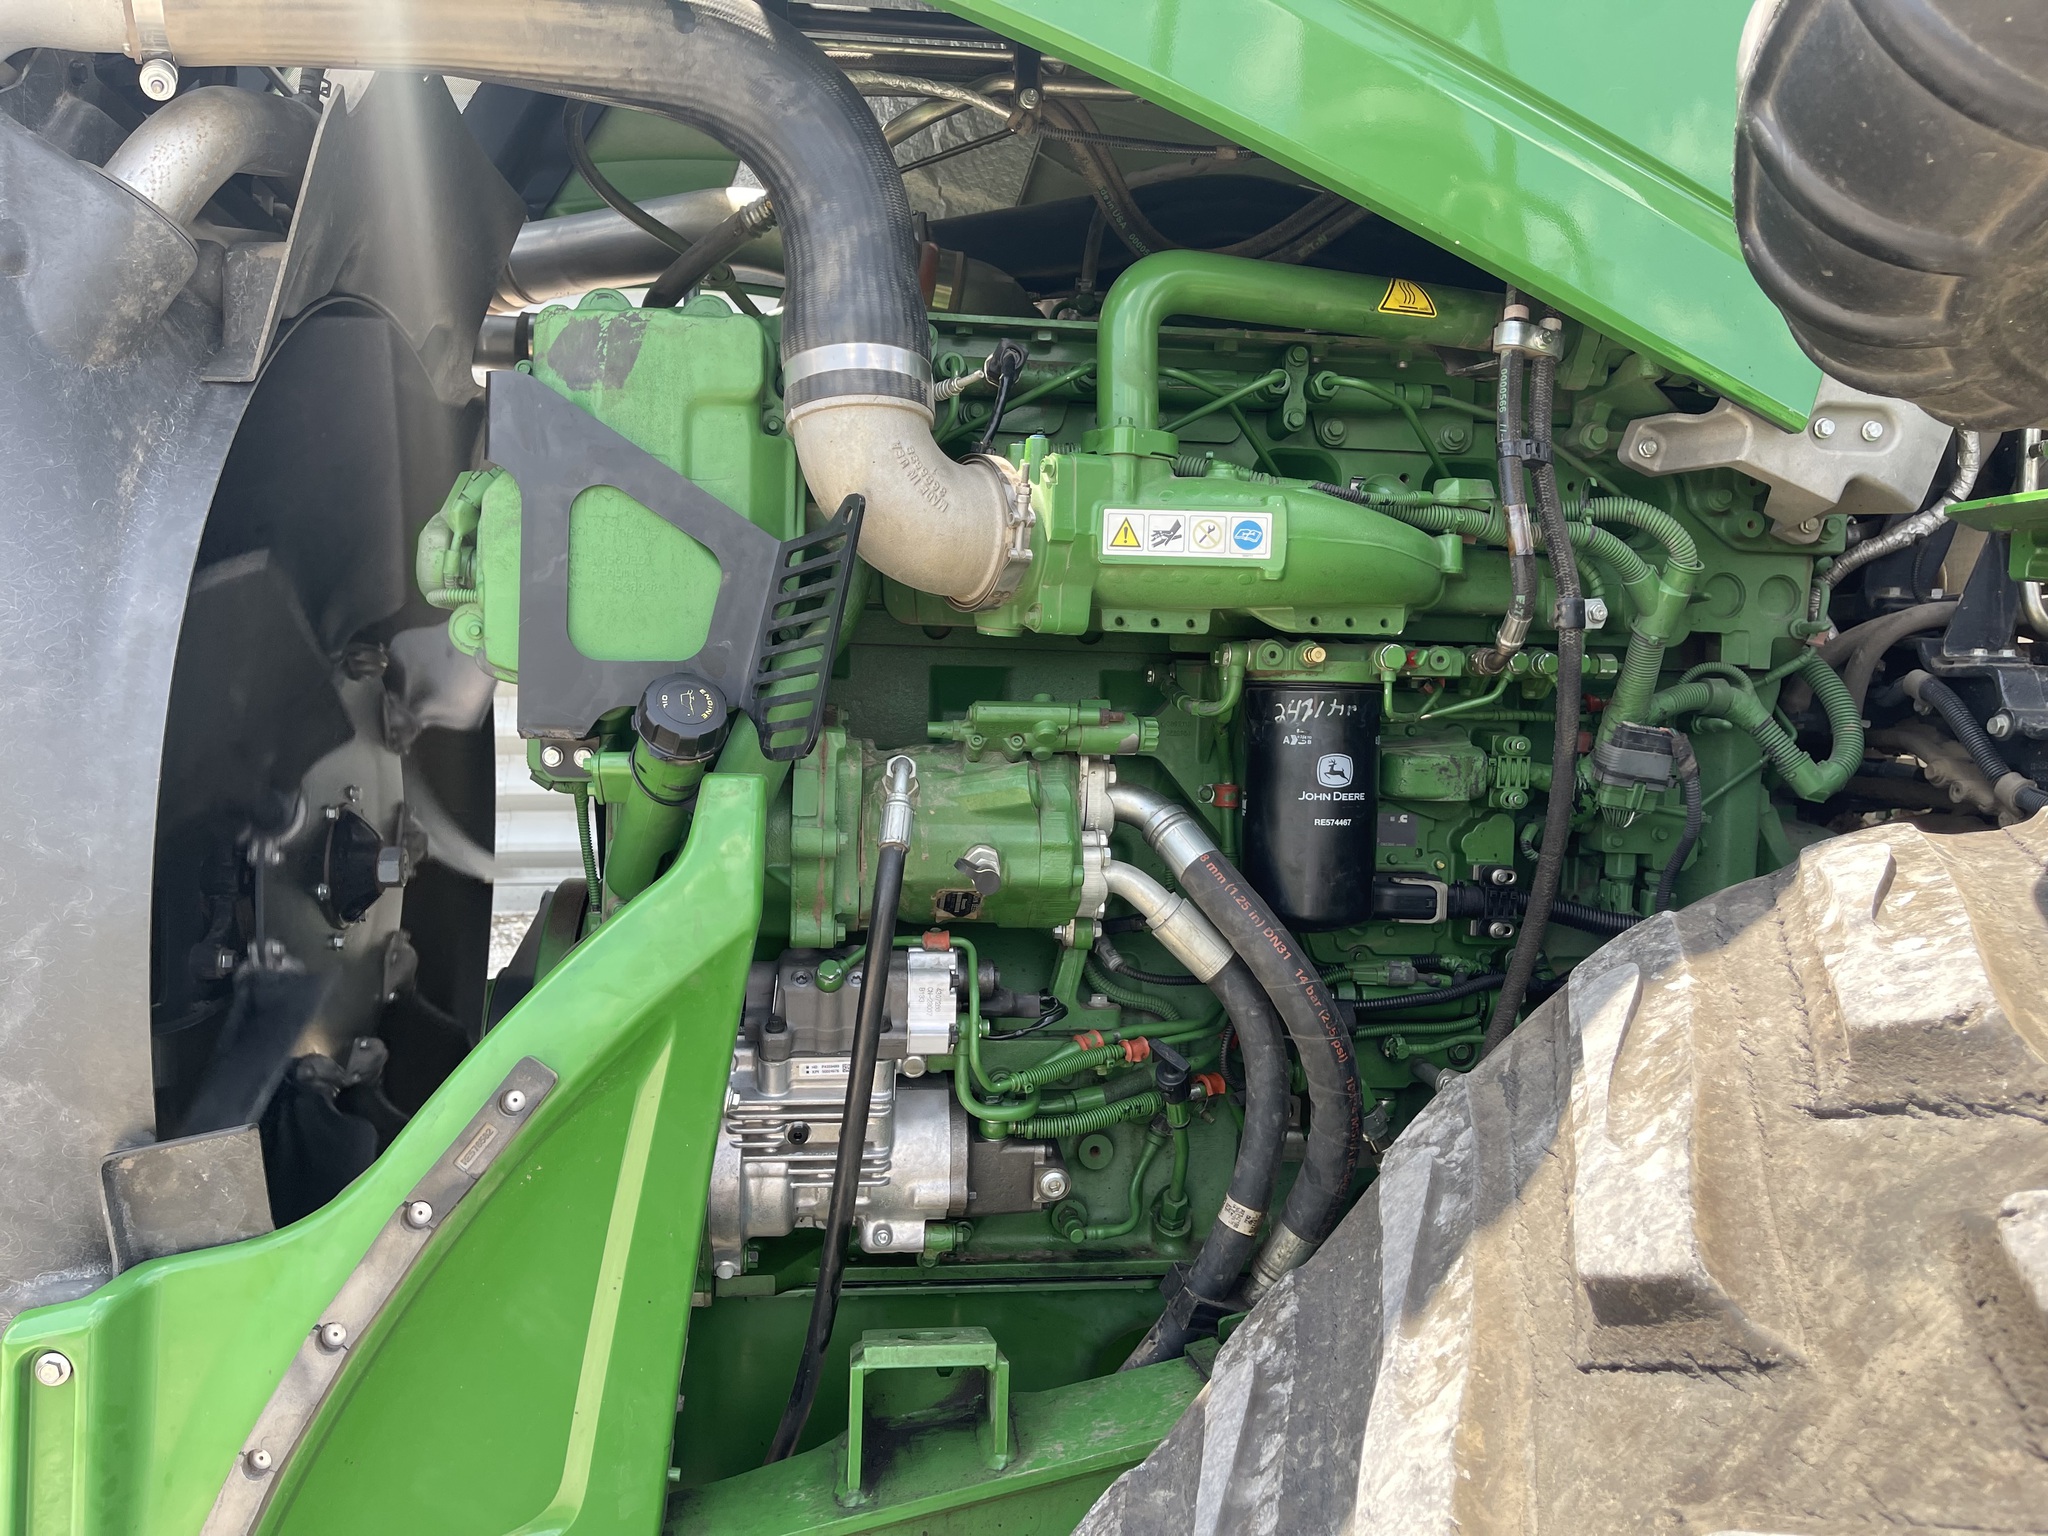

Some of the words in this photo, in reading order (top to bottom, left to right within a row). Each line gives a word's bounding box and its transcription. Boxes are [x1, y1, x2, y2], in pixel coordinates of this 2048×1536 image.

[1112, 209, 1127, 230] USA
[1500, 368, 1508, 413] 0000566
[699, 688, 714, 719] ENGINE
[1298, 791, 1331, 801] JOHN
[1333, 792, 1365, 801] DEERE
[1314, 818, 1351, 826] RE574467
[1206, 862, 1226, 884] mm
[1224, 883, 1252, 911] (1.25
[1248, 910, 1265, 928] in)
[1263, 927, 1292, 960] DN31
[1295, 968, 1309, 984] 14
[1306, 985, 1321, 1007] bar
[1330, 1040, 1348, 1063] psi)
